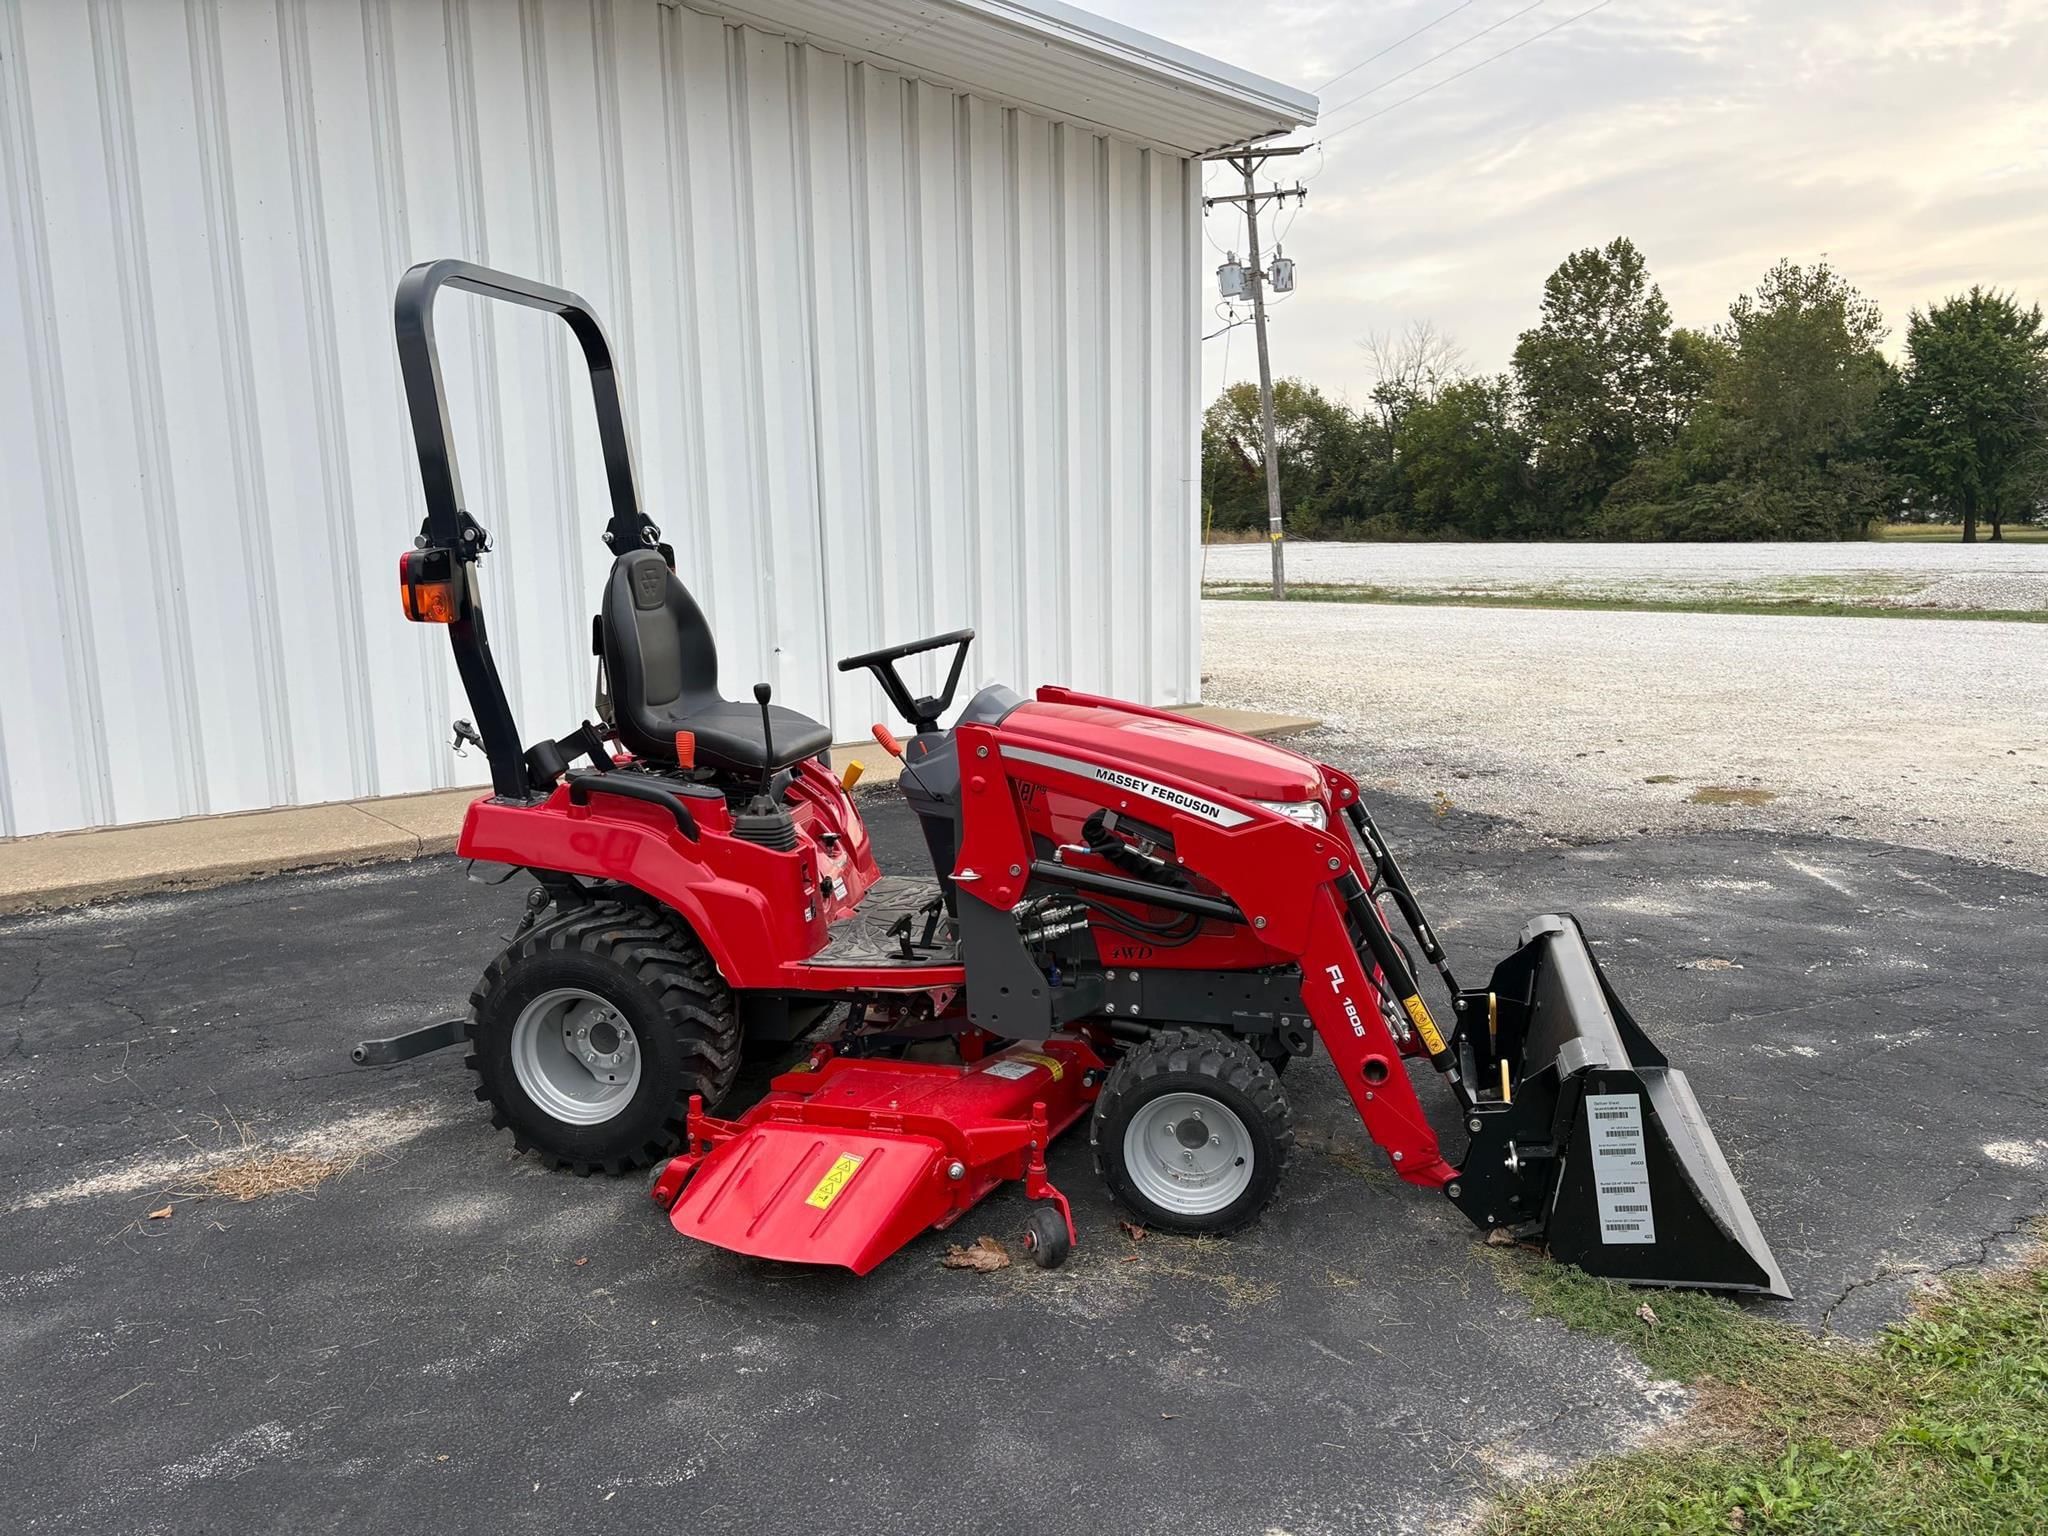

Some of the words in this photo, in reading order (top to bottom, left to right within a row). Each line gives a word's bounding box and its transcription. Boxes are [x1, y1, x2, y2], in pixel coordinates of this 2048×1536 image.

[1095, 768, 1149, 792] MASSEY
[1151, 786, 1220, 818] FERGUSON
[1112, 946, 1153, 960] 4WD
[1325, 964, 1345, 994] FL
[1342, 996, 1366, 1037] 1805
